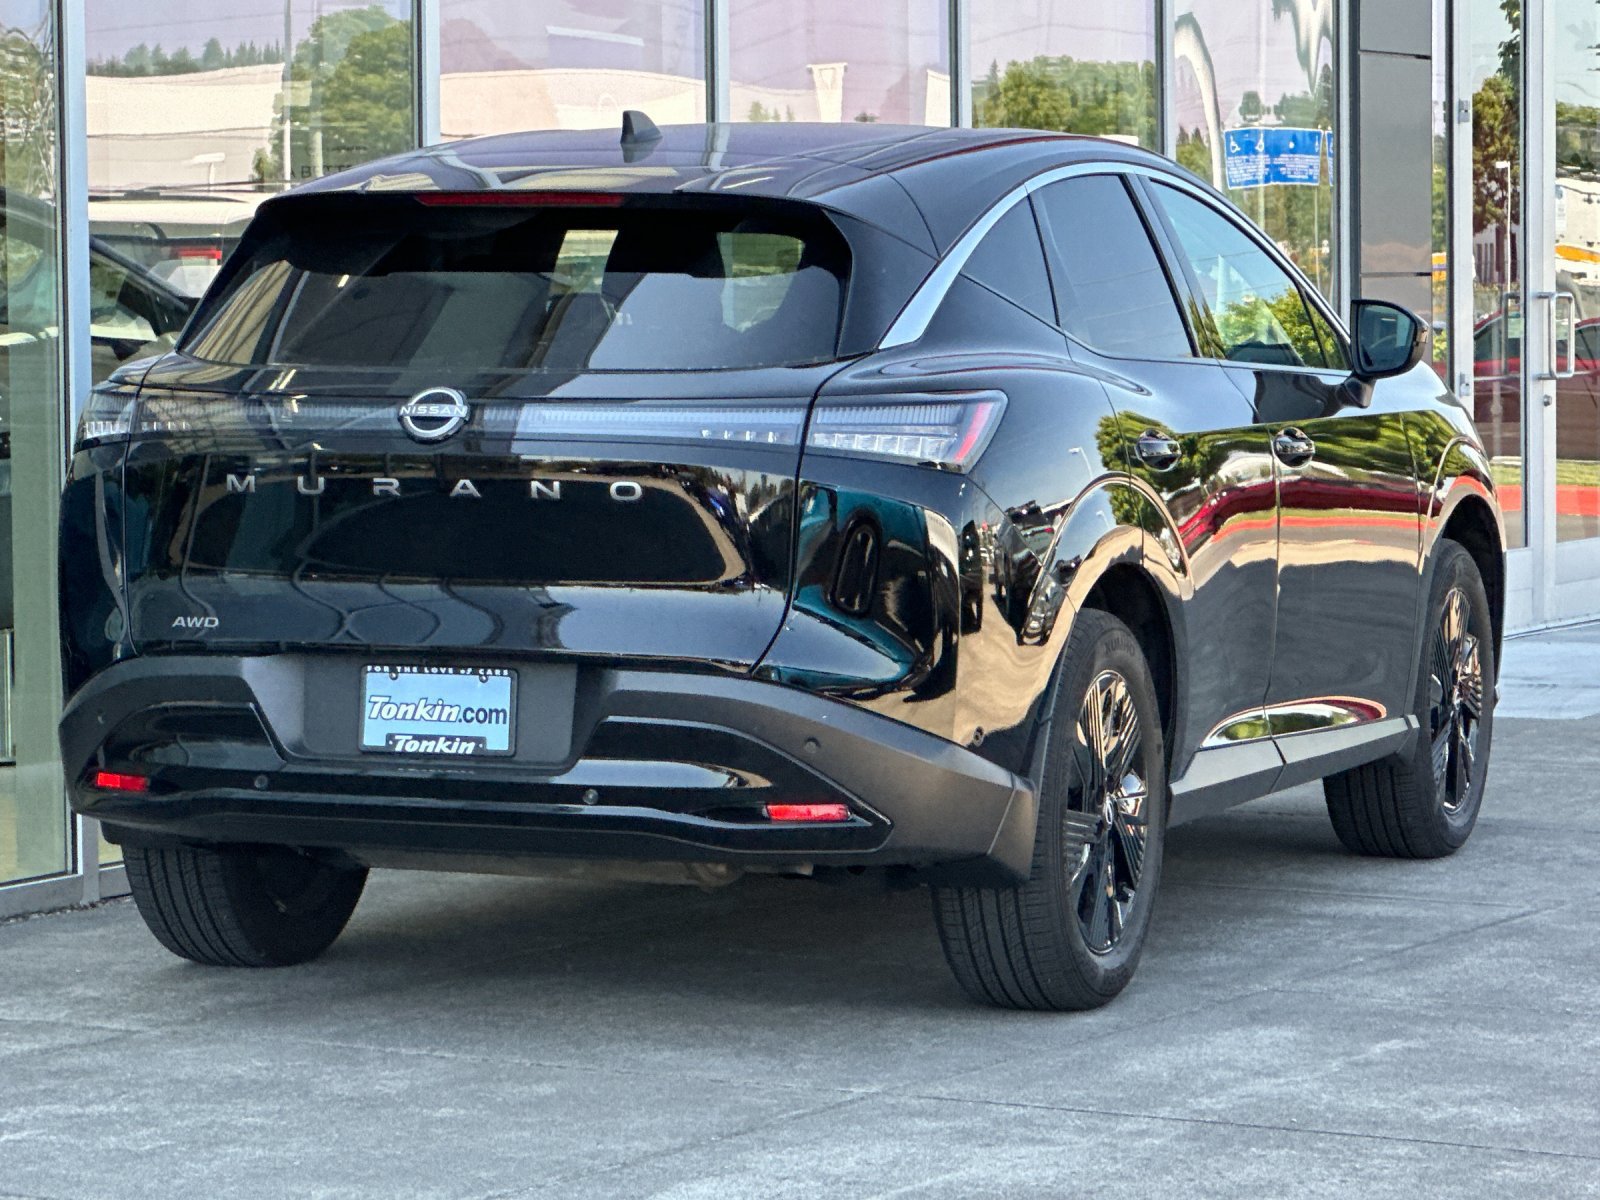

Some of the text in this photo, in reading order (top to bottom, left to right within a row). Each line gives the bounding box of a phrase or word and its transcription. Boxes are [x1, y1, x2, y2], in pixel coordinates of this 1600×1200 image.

[400, 405, 466, 416] NISSAN
[226, 473, 644, 502] MURANO
[172, 616, 219, 628] AWD
[367, 665, 390, 673] FOR
[424, 666, 454, 674] LOVE
[479, 668, 509, 676] CARS
[368, 695, 508, 724] Tonkin.com
[394, 734, 476, 755] Tonkin
